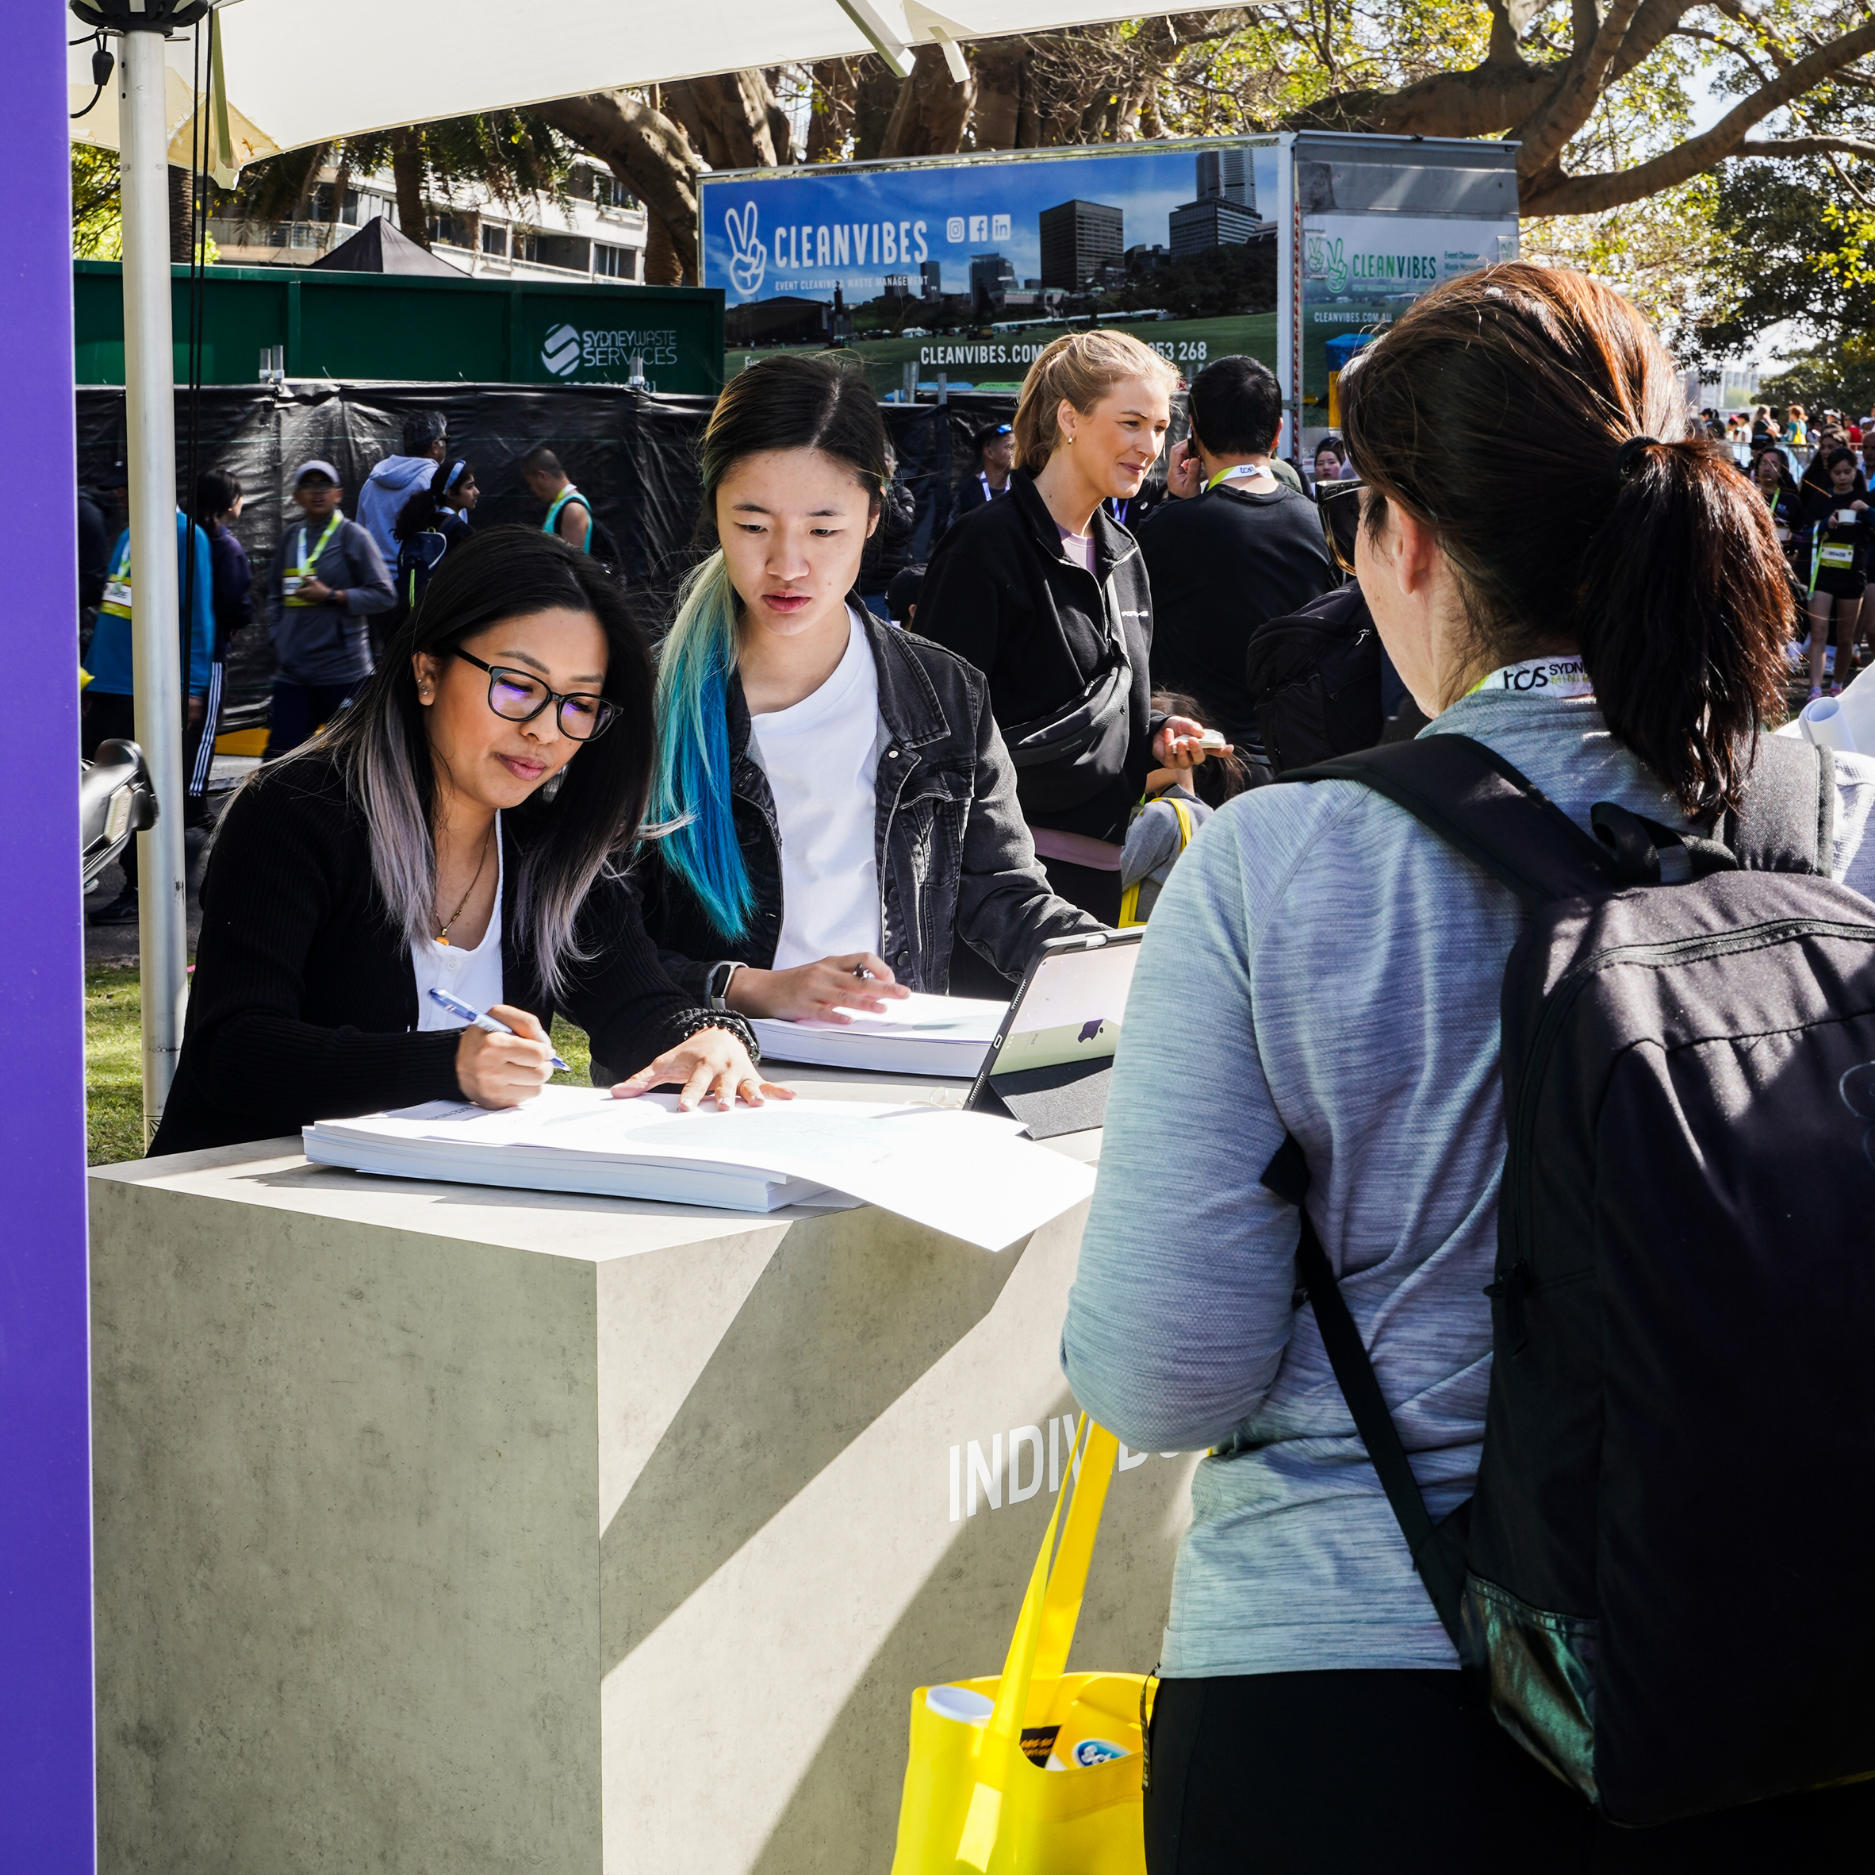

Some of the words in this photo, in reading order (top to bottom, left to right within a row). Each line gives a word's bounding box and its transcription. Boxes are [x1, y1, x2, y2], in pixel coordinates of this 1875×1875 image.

[774, 219, 929, 269] CLEANVIBES
[1352, 253, 1437, 280] CLEANVIBES
[775, 280, 798, 291] EVENT
[800, 278, 835, 290] CLEANING
[847, 277, 873, 288] WASTE
[875, 275, 929, 286] MANAGEMENT
[582, 346, 678, 366] SERVICES
[1178, 341, 1207, 361] 268
